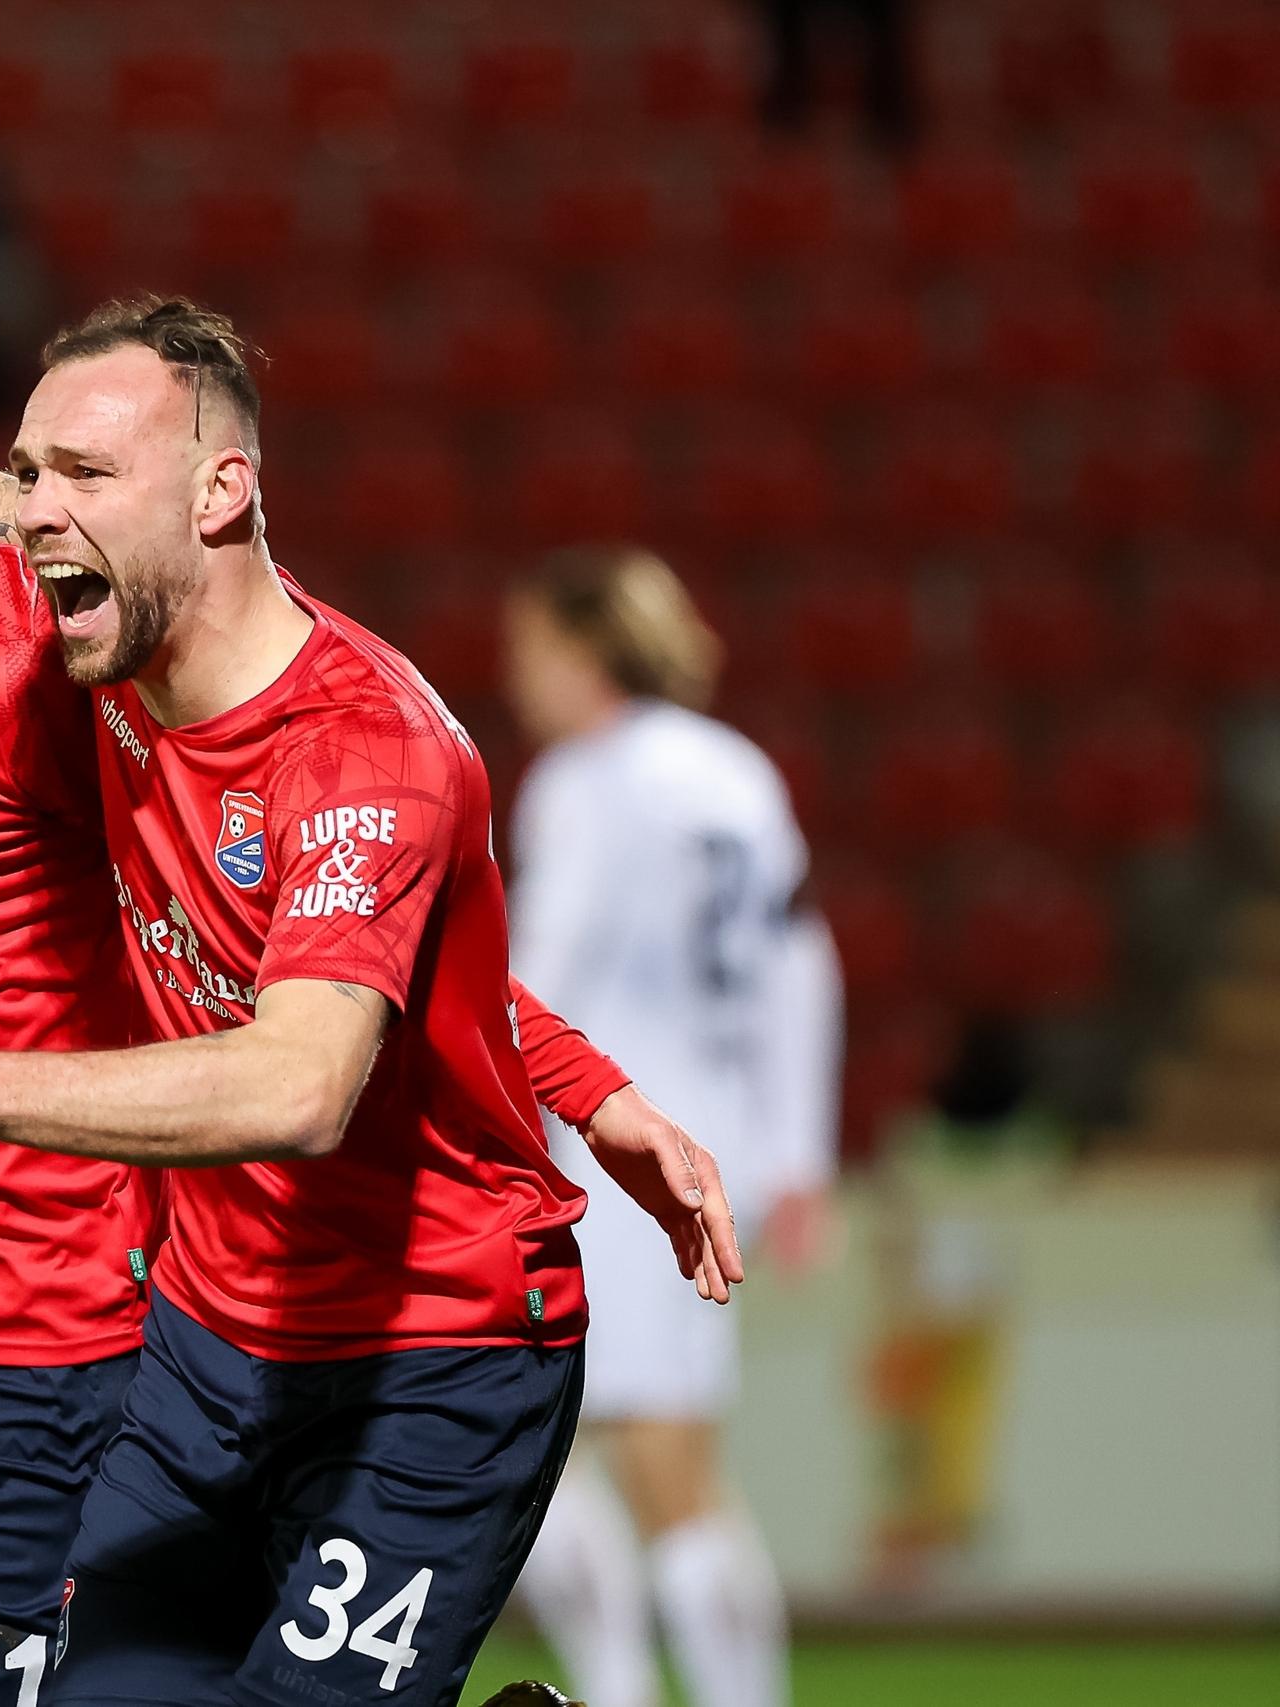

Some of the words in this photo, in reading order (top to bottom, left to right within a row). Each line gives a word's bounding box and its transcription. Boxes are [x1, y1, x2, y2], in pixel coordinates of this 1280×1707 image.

[300, 805, 397, 853] LUPSE
[317, 838, 368, 885] &
[286, 882, 378, 918] LUPSE
[280, 1538, 433, 1691] 34
